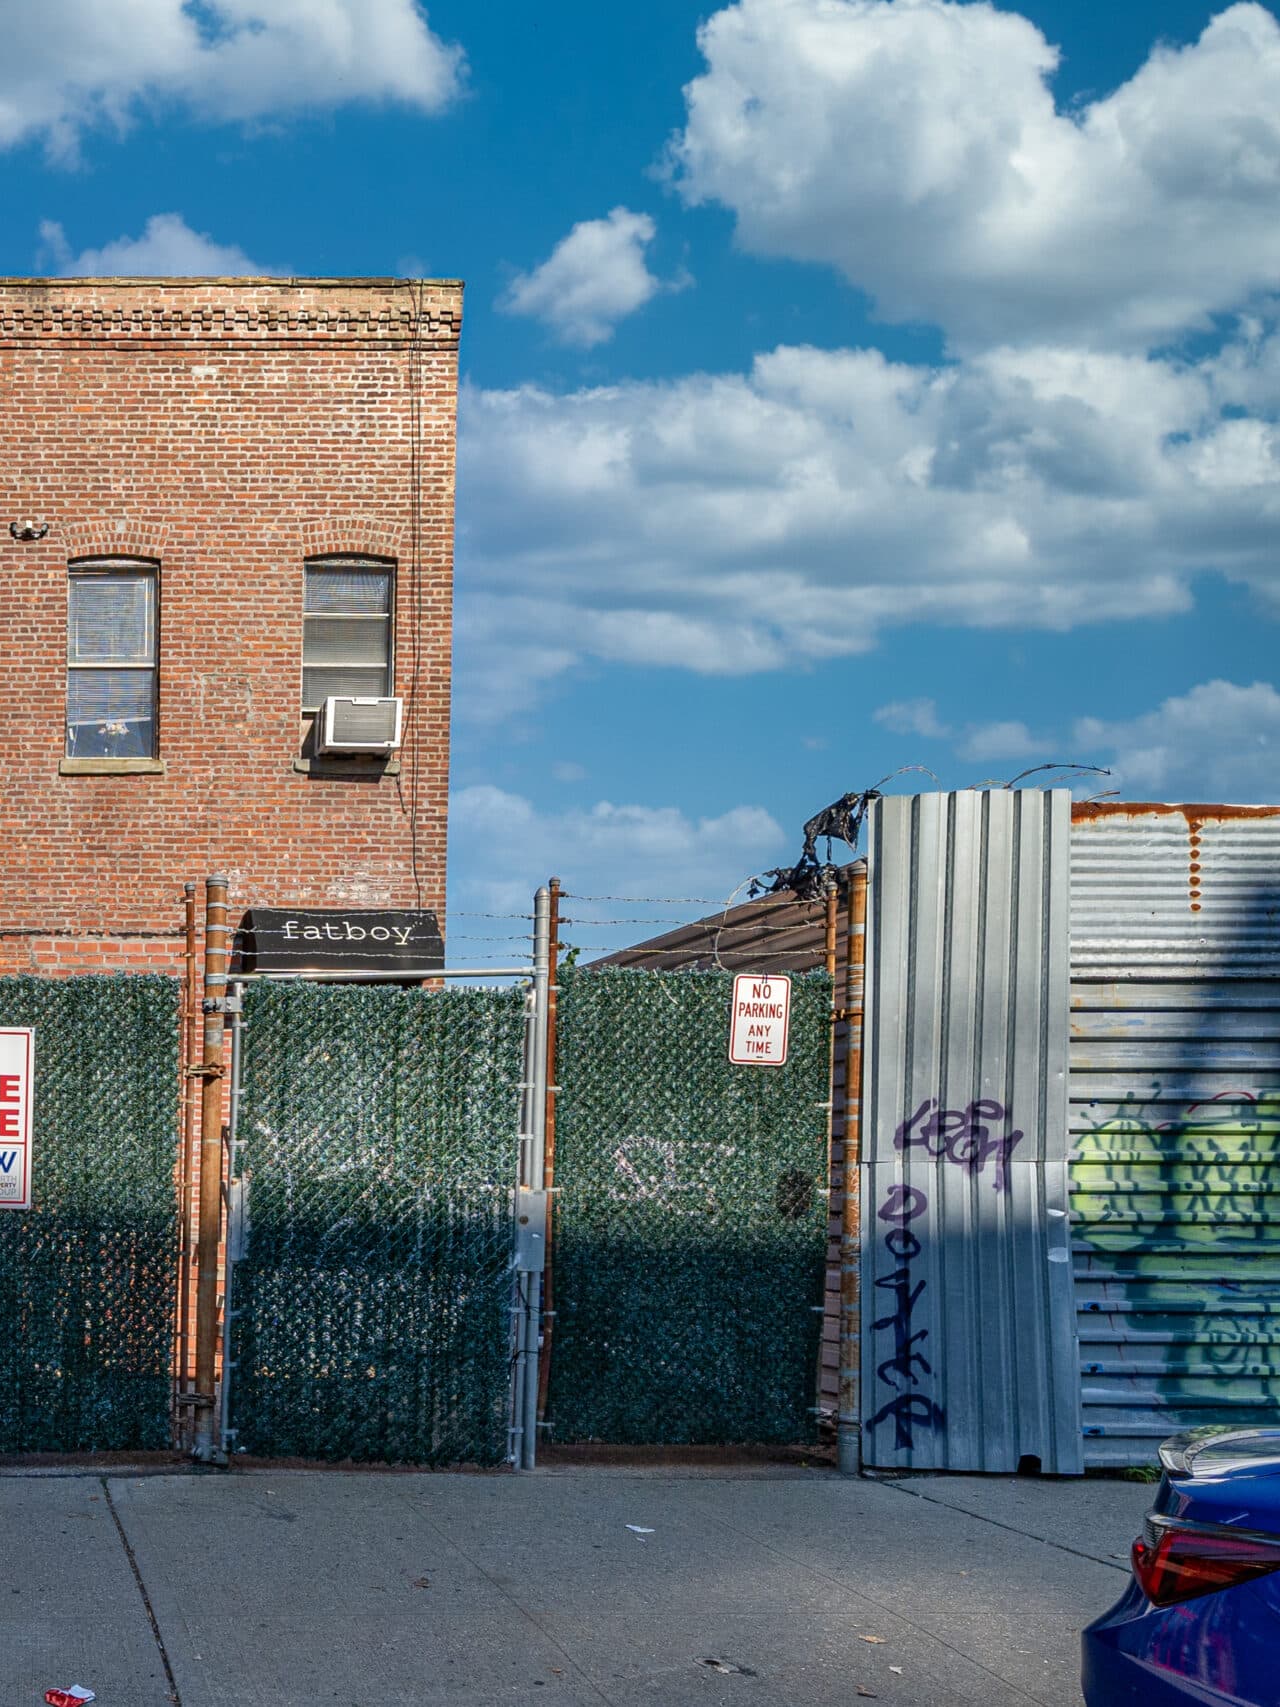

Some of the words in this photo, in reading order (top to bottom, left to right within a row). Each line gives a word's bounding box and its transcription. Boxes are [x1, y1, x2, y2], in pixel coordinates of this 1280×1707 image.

[282, 921, 412, 945] fatboy
[752, 983, 772, 999] NO
[738, 1002, 783, 1018] PARKING
[748, 1024, 772, 1037] ANY
[746, 1040, 772, 1054] TIME
